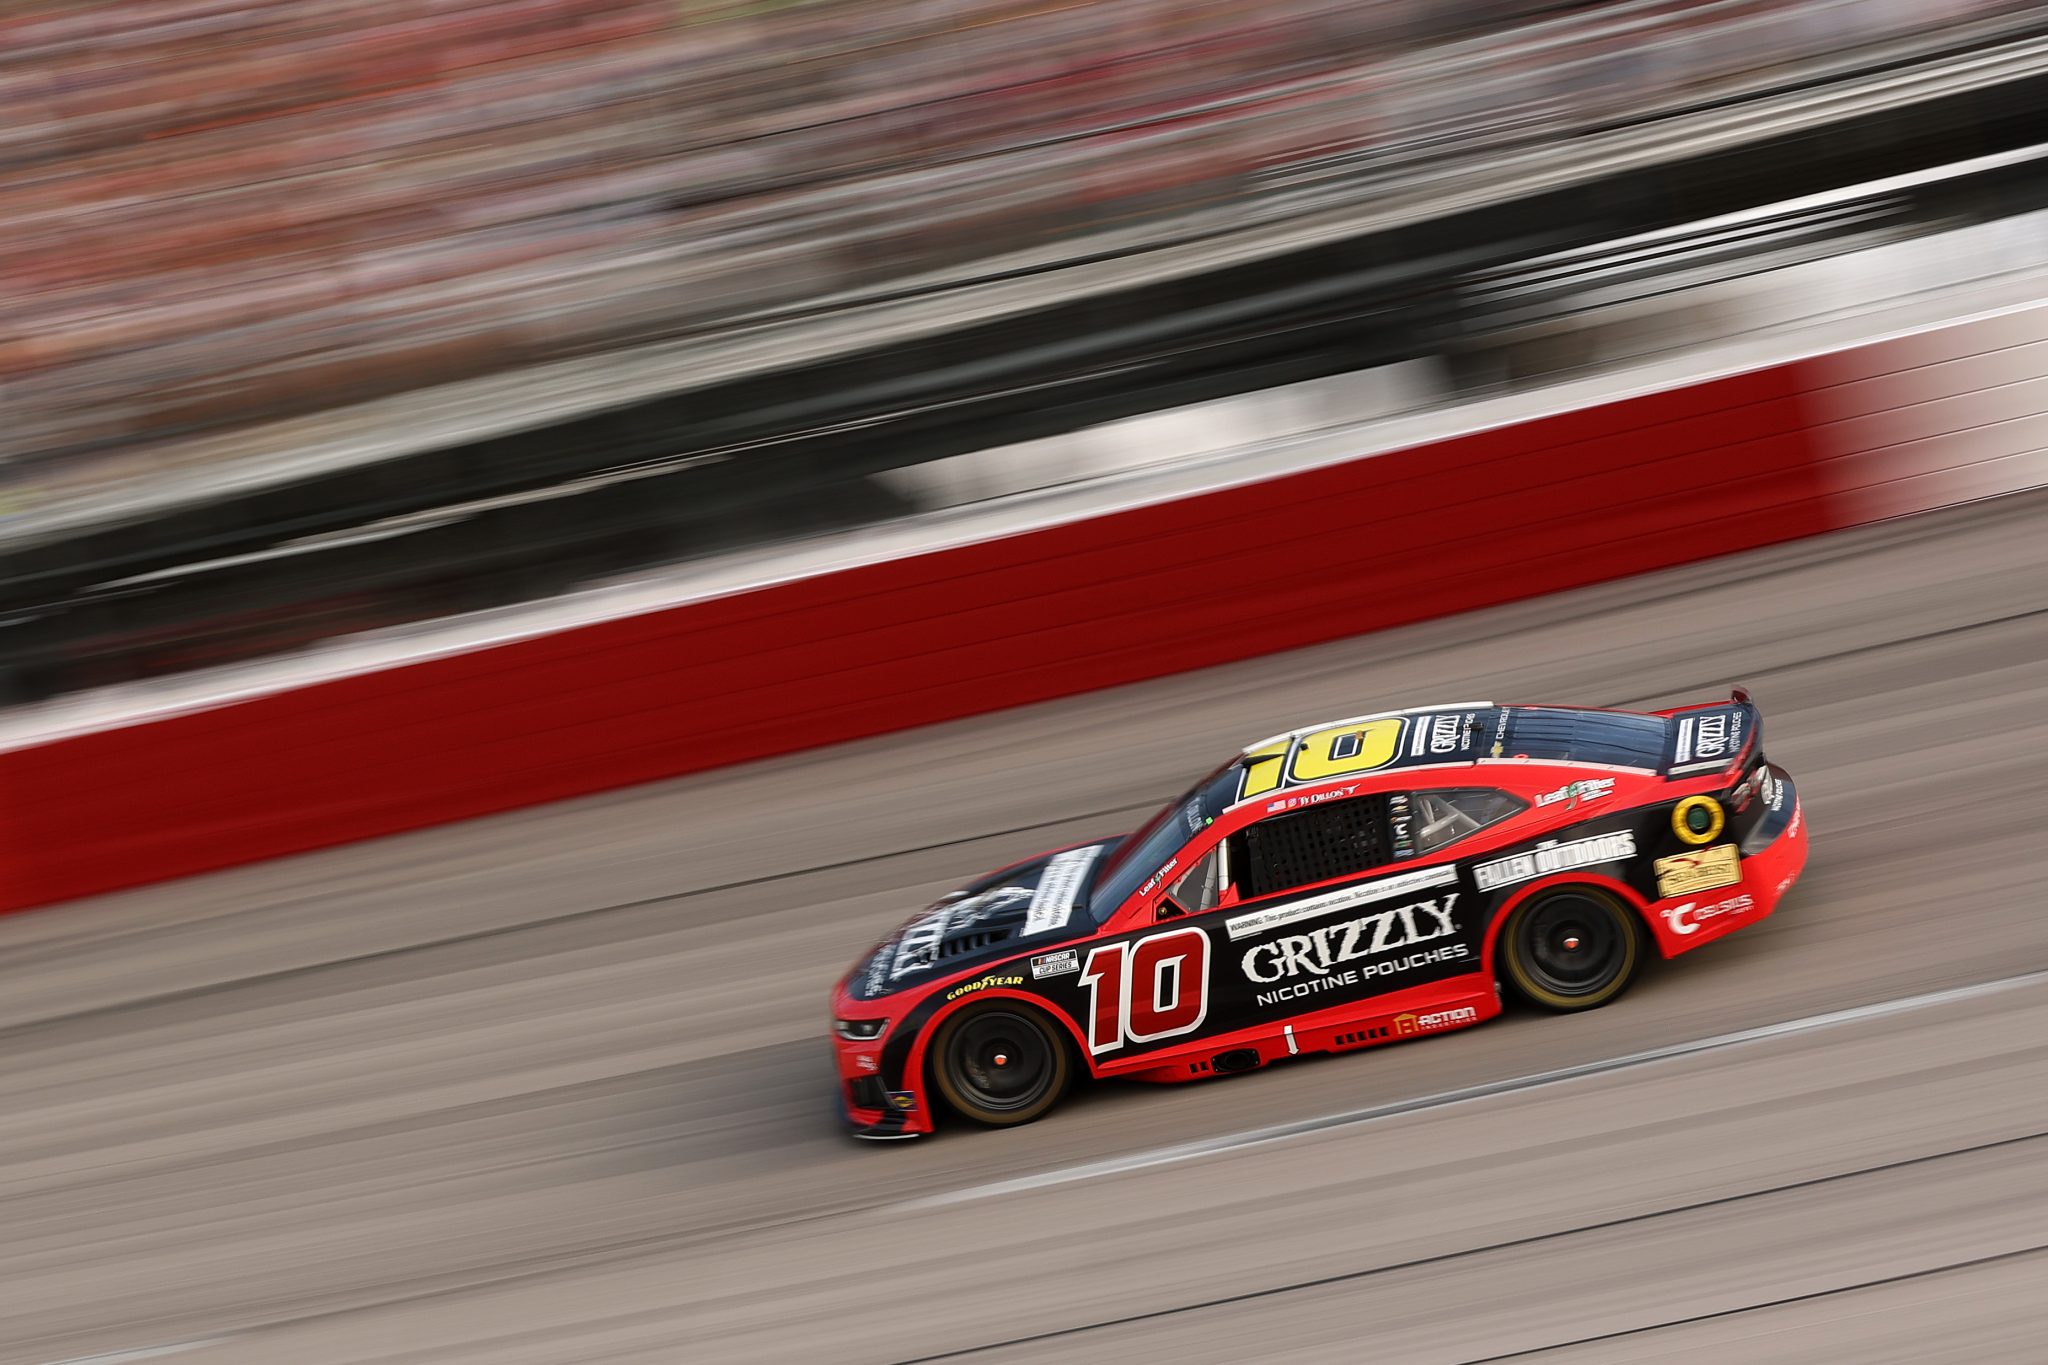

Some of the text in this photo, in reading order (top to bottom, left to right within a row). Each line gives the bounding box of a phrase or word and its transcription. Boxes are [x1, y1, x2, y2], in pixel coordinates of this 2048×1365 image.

[1430, 714, 1461, 754] GRIZZLY
[1695, 714, 1729, 758] GRIZZLY
[1237, 716, 1411, 804] 10
[1045, 951, 1070, 964] NASCAR
[1241, 893, 1461, 983] GRIZZLY
[947, 974, 1024, 1001] GOODYEAR
[1052, 961, 1073, 972] SERIES
[1256, 943, 1470, 1007] NICOTINE POUCHES
[1077, 926, 1212, 1057] 10
[1418, 1006, 1476, 1026] ACTION
